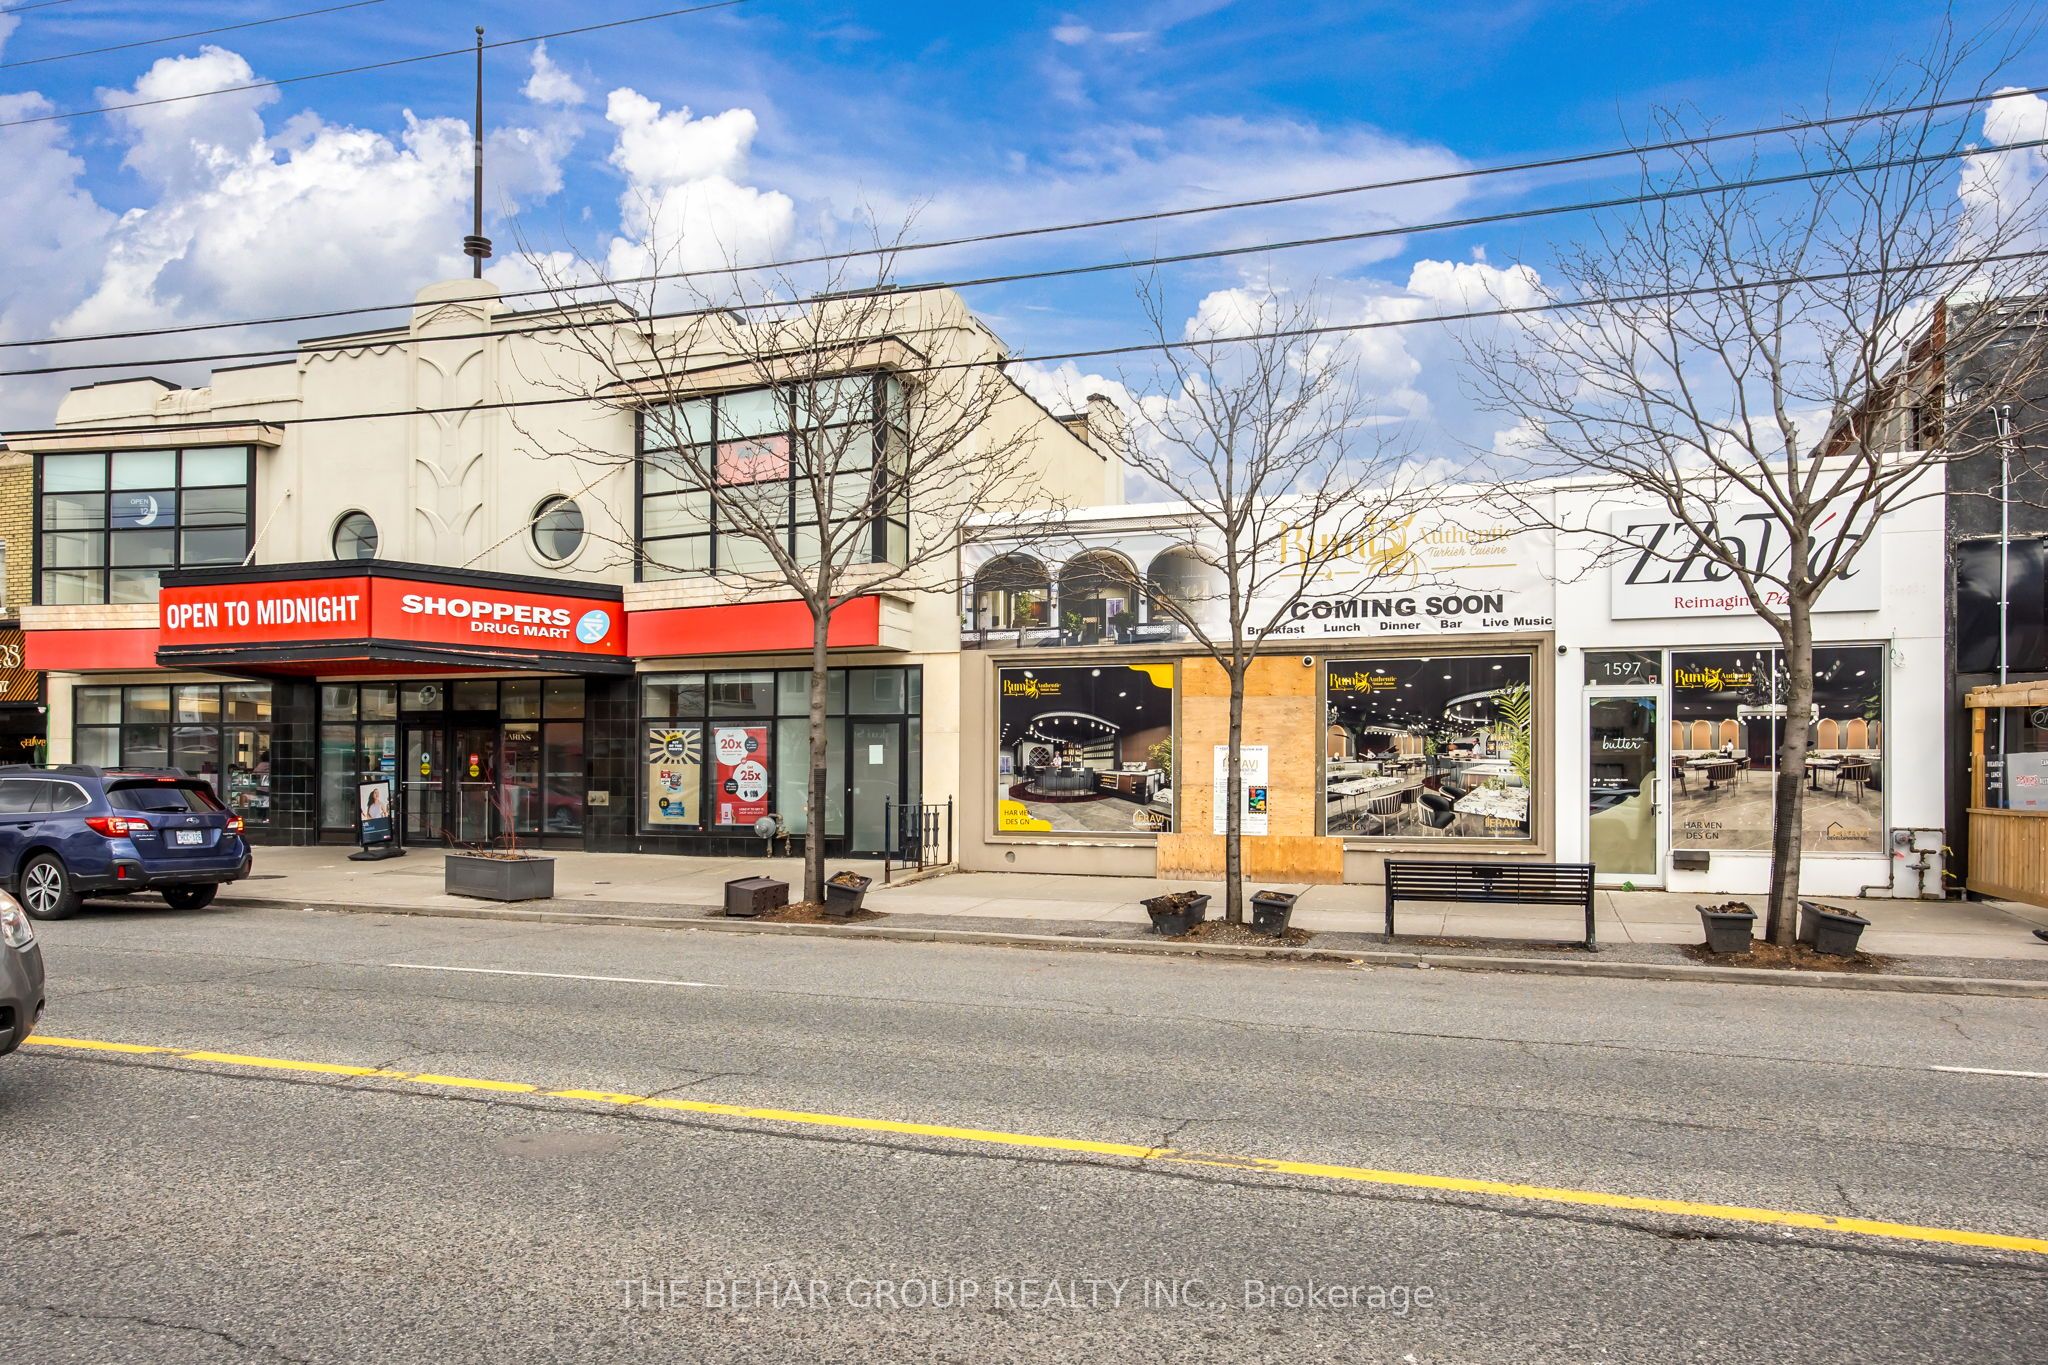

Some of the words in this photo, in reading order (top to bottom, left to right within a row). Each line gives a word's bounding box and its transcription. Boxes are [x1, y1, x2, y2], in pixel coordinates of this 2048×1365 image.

[400, 594, 571, 627] SHOPPERS
[1290, 598, 1416, 621] COMING
[1425, 594, 1504, 616] SOON
[1674, 595, 1750, 611] Reimagin
[166, 602, 219, 630] OPEN
[224, 600, 250, 627] TO
[256, 595, 360, 626] MIDNIGHT
[470, 621, 520, 635] DRUG
[523, 625, 570, 639] MART
[1247, 624, 1306, 636] Brkfast
[1323, 623, 1361, 633] Lunch
[1380, 621, 1421, 631] Dinner
[1440, 619, 1463, 629] Bar
[1482, 618, 1509, 627] Live
[1513, 616, 1553, 627] Music
[1604, 662, 1641, 676] 1597
[720, 738, 742, 750] 20x
[1602, 735, 1641, 750] butter
[740, 770, 761, 781] 25x
[1686, 832, 1719, 840] DESGN
